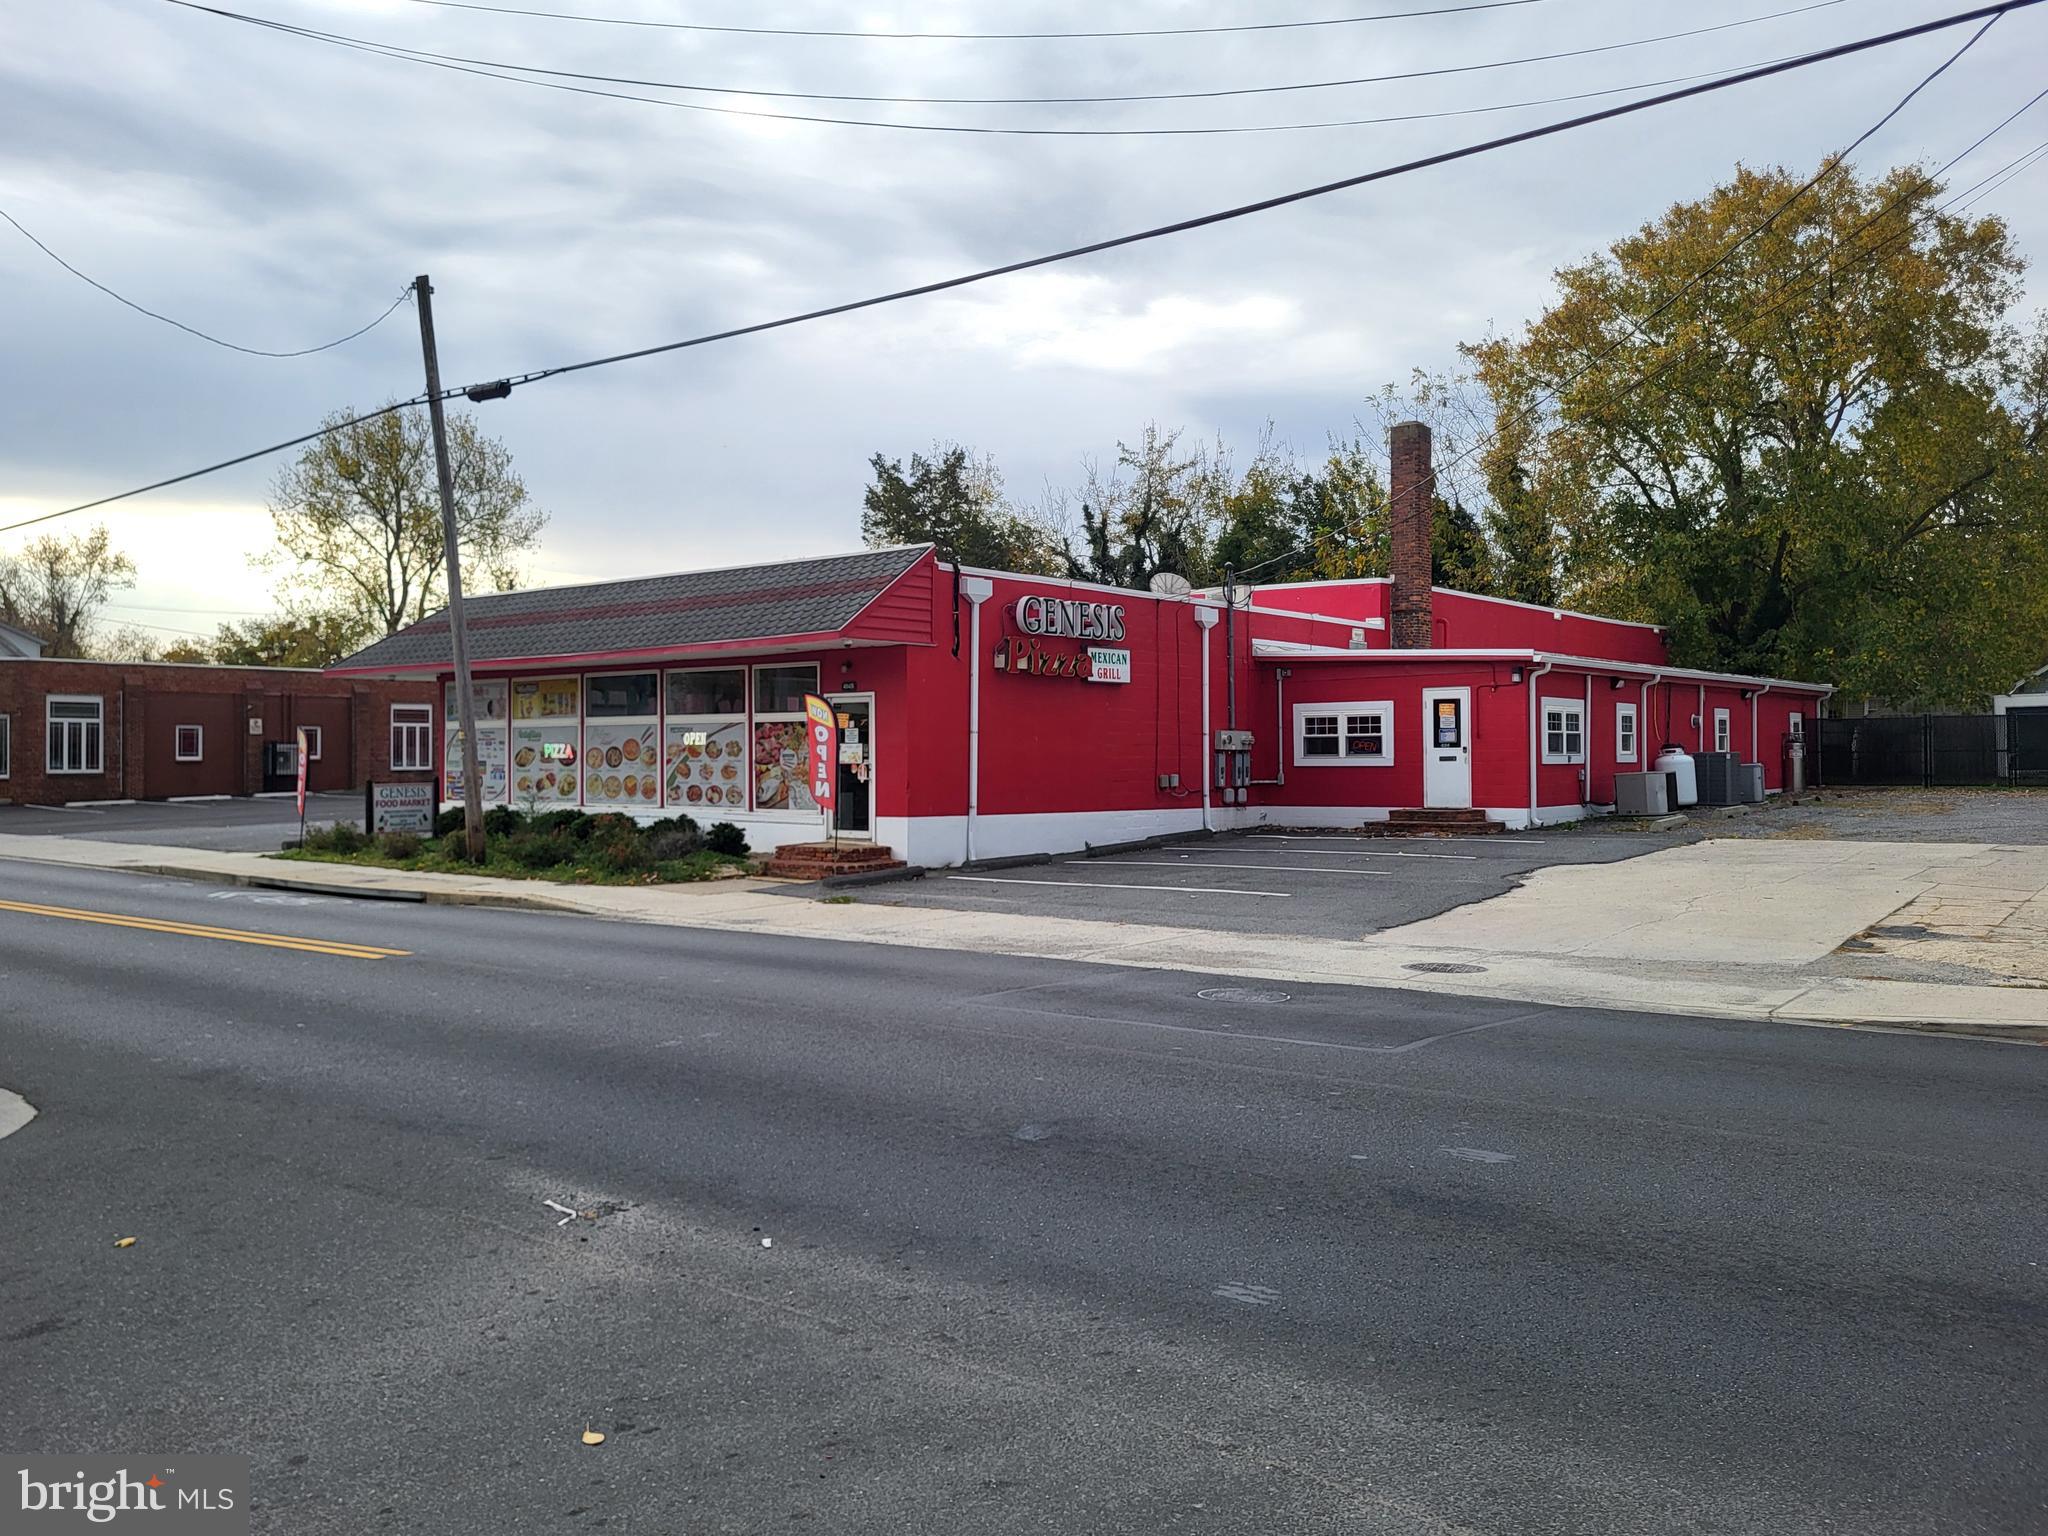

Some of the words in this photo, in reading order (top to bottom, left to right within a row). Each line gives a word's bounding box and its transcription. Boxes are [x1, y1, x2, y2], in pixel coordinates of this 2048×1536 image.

[1016, 595, 1126, 642] GENESIS
[1007, 635, 1094, 679] Pizza
[1091, 651, 1128, 665] MEXICAN
[1097, 667, 1121, 680] GRILL
[682, 731, 708, 746] OPEN
[543, 743, 575, 760] PIZZA
[1352, 740, 1377, 752] OPEN
[379, 786, 427, 799] GENESIS
[375, 799, 398, 808] FOOD
[399, 798, 431, 807] MARKET
